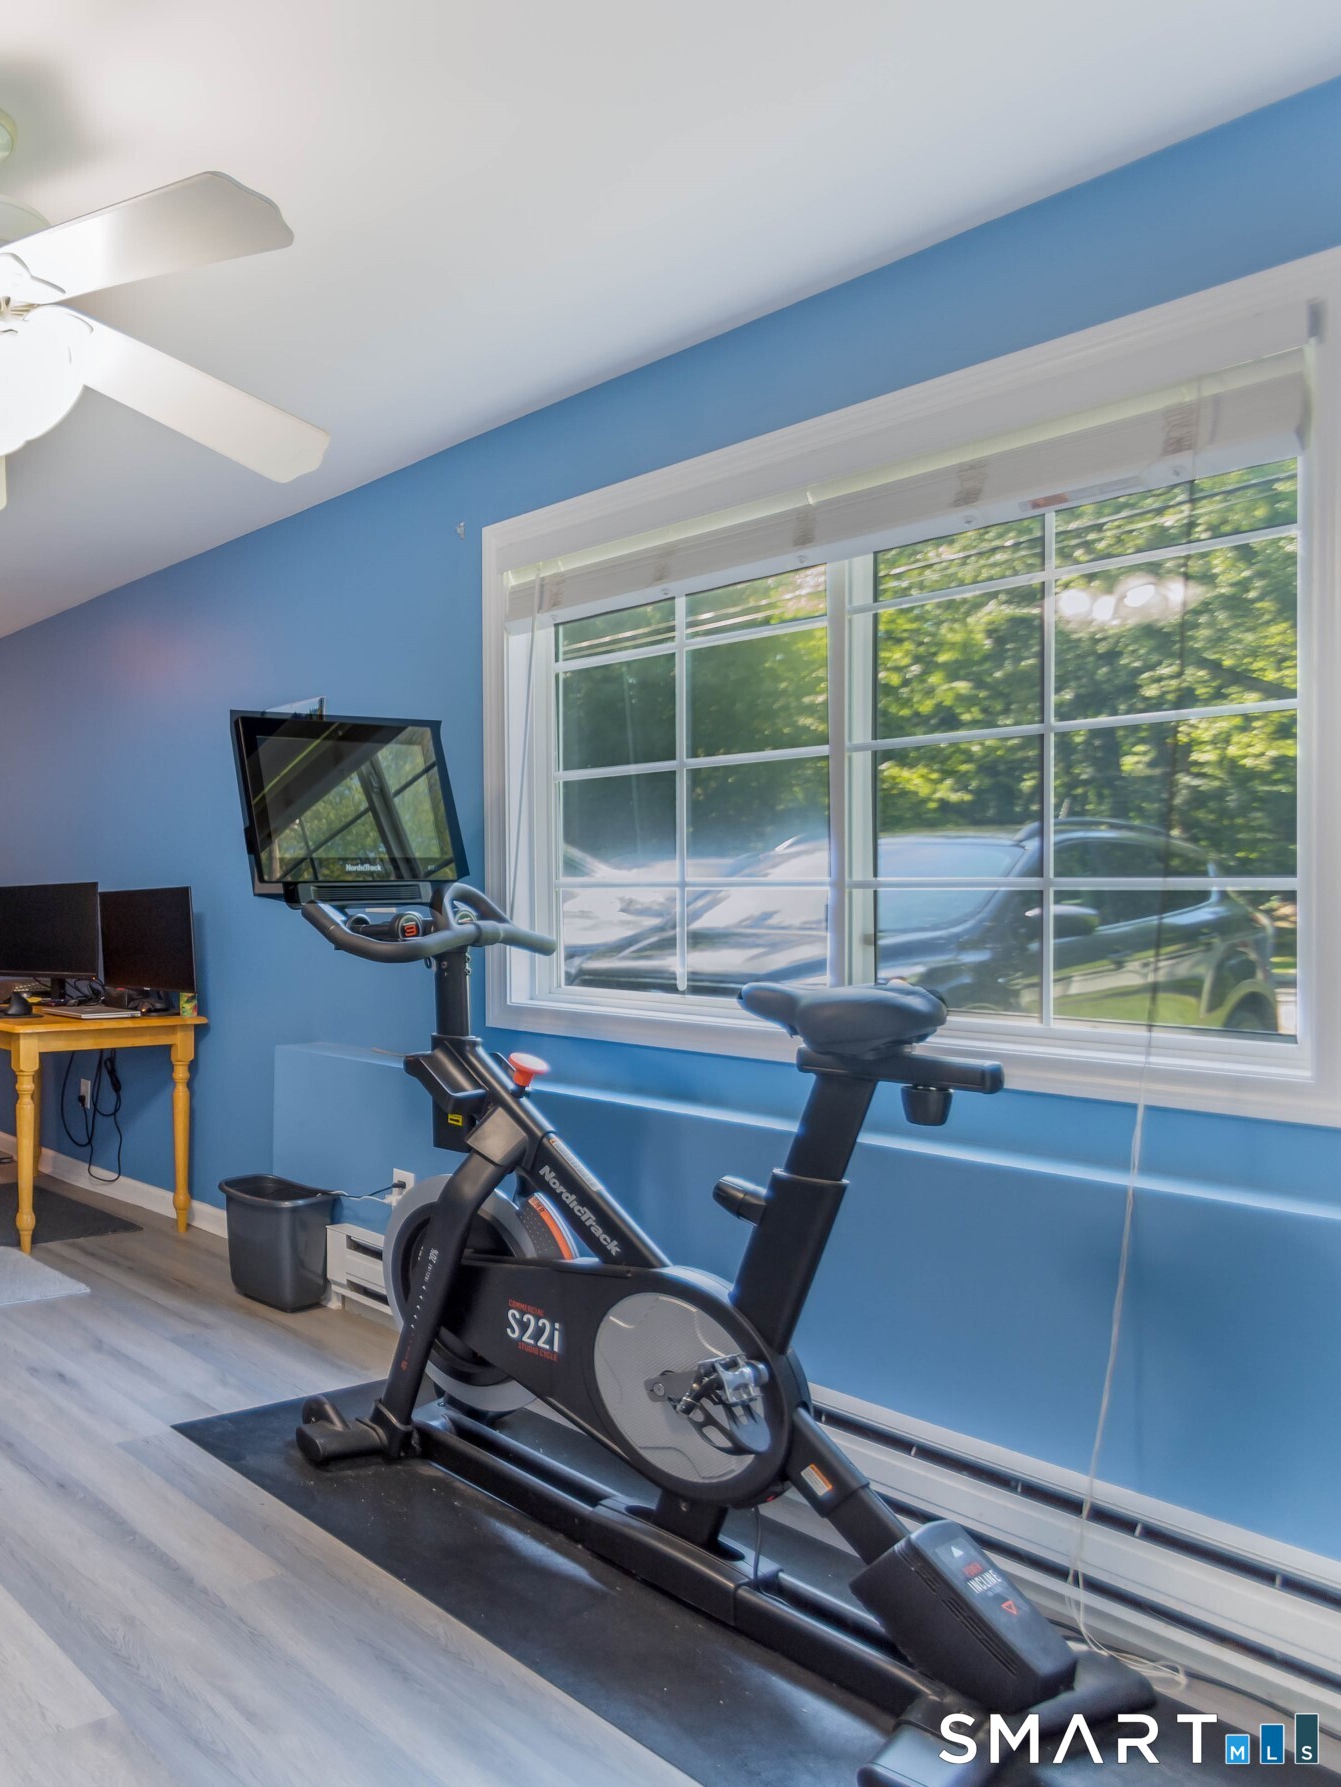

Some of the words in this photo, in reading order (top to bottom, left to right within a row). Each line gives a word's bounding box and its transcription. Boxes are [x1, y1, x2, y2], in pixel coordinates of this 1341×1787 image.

[346, 864, 381, 872] NordicTrack
[539, 1165, 620, 1256] NordicTrack
[429, 1248, 439, 1264] 20%
[509, 1298, 545, 1317] COMMERCIAL
[506, 1308, 560, 1352] S22i
[966, 1569, 1002, 1594] INCLINE
